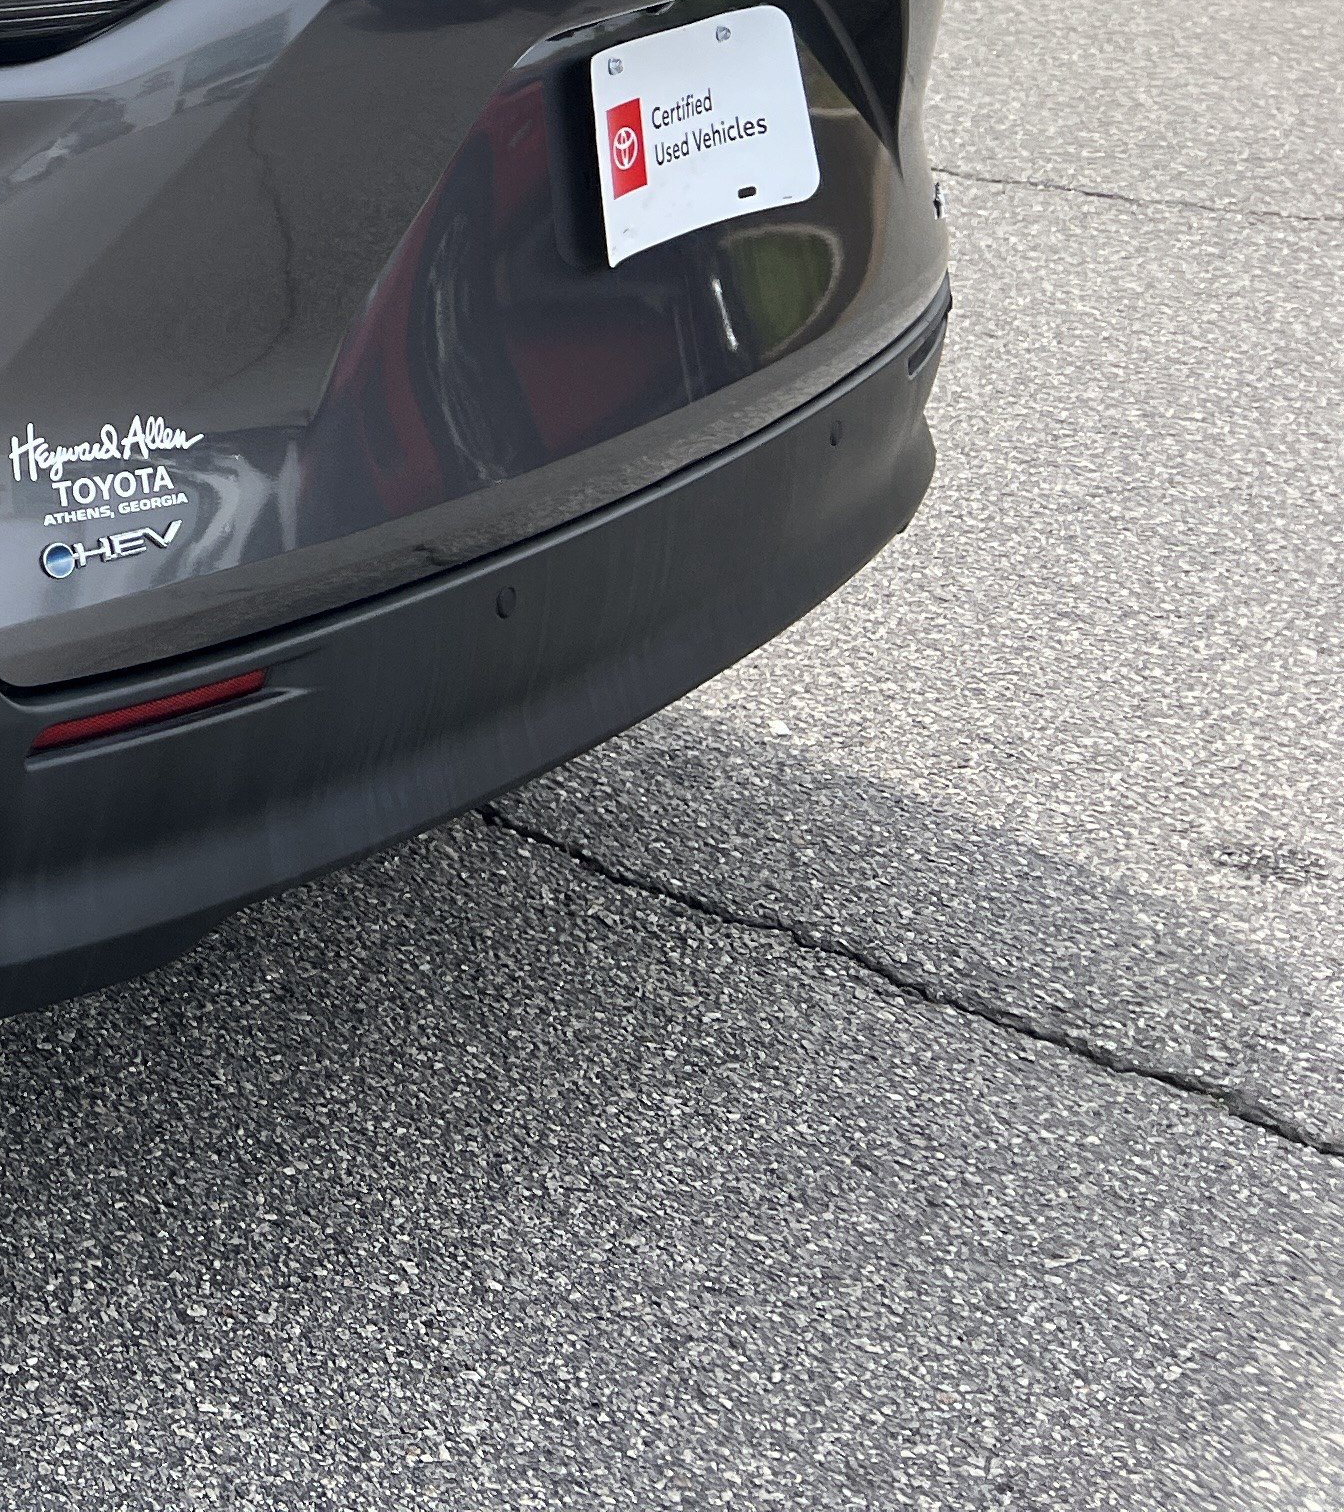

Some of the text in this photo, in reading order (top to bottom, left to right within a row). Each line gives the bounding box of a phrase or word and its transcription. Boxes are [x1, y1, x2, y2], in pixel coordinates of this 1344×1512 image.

[651, 88, 713, 130] Certified
[655, 115, 768, 166] Used Vehicles
[9, 414, 205, 481] Heyward Allen
[51, 465, 174, 507] TOYOTA
[43, 492, 189, 528] ATHENS, GEORGIA
